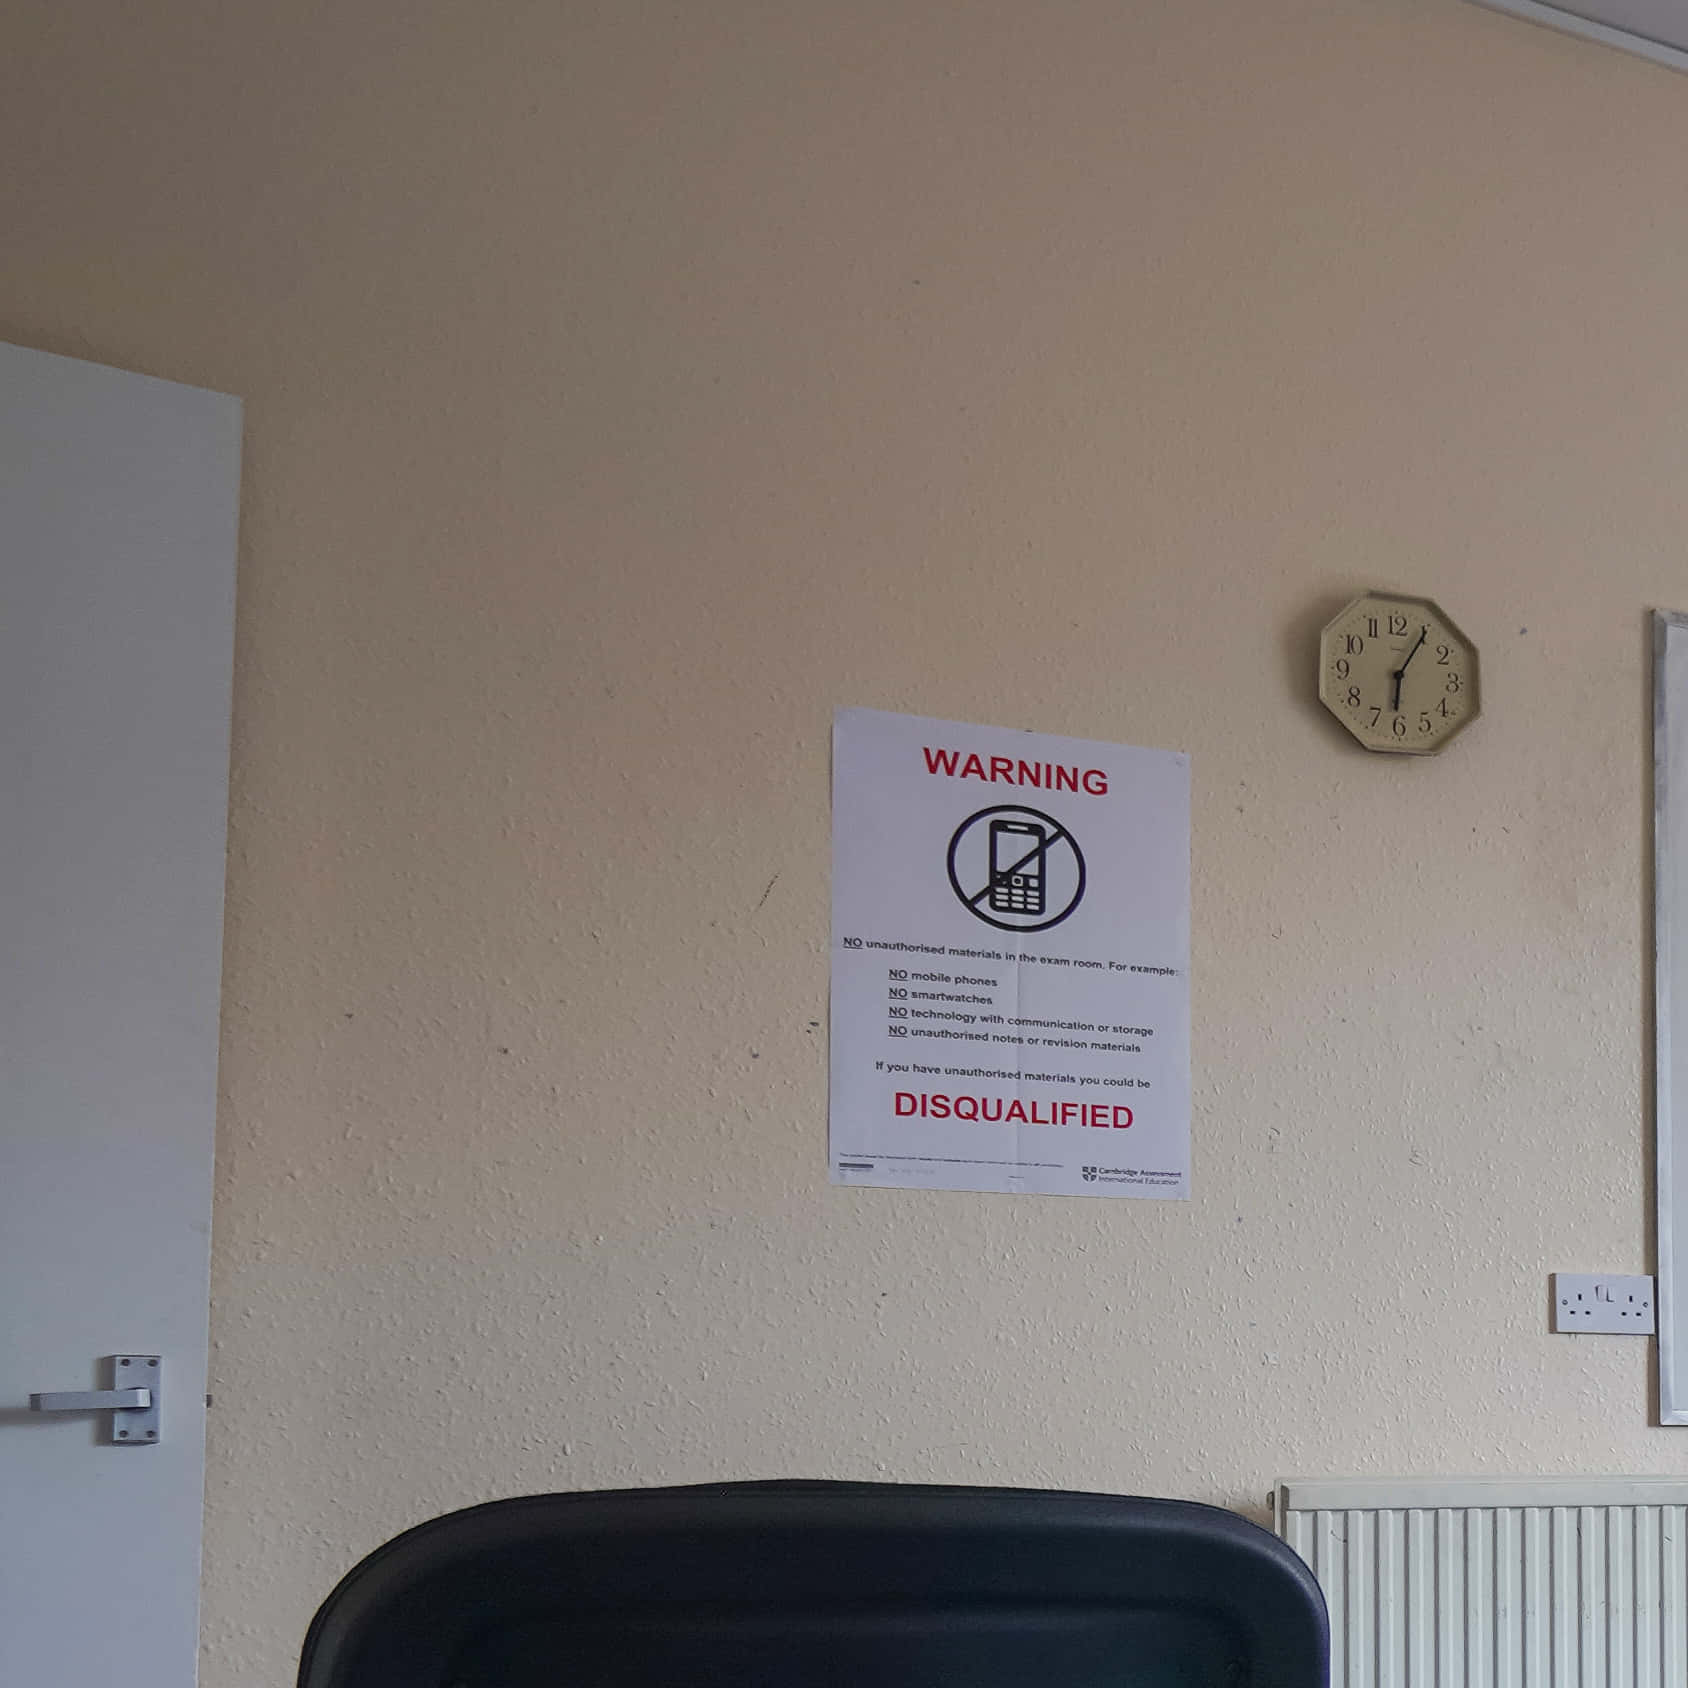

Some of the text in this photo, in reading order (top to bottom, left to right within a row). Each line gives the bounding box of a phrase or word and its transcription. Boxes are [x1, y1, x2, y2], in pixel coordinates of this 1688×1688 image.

[1368, 618, 1378, 638] 11
[1388, 615, 1408, 637] 12
[1346, 634, 1364, 656] 10
[1436, 645, 1449, 666] 2
[1336, 659, 1349, 680] 9
[1446, 673, 1459, 694] 3
[1348, 686, 1361, 708] 8
[1436, 698, 1449, 717] 4
[1370, 707, 1382, 728] 7
[1392, 715, 1406, 737] 6
[1418, 712, 1431, 733] 5
[923, 746, 1109, 796] WARNING
[843, 937, 863, 950] NO
[866, 939, 946, 955] unauthorised
[949, 947, 1002, 960] materials
[1005, 951, 1016, 961] in
[1019, 953, 1037, 964] the
[1040, 957, 1070, 967] exam
[1109, 961, 1127, 972] For
[888, 969, 998, 988] NO mobile phones
[888, 988, 993, 1005] NO smartwatches
[888, 1006, 1154, 1037] NO technology with communication or storage
[888, 1025, 1141, 1053] NO unauthorised notes or revision materials
[875, 1061, 1151, 1089] If you have unauthorised materials you could be
[895, 1092, 1134, 1129] DISQUALIFIED
